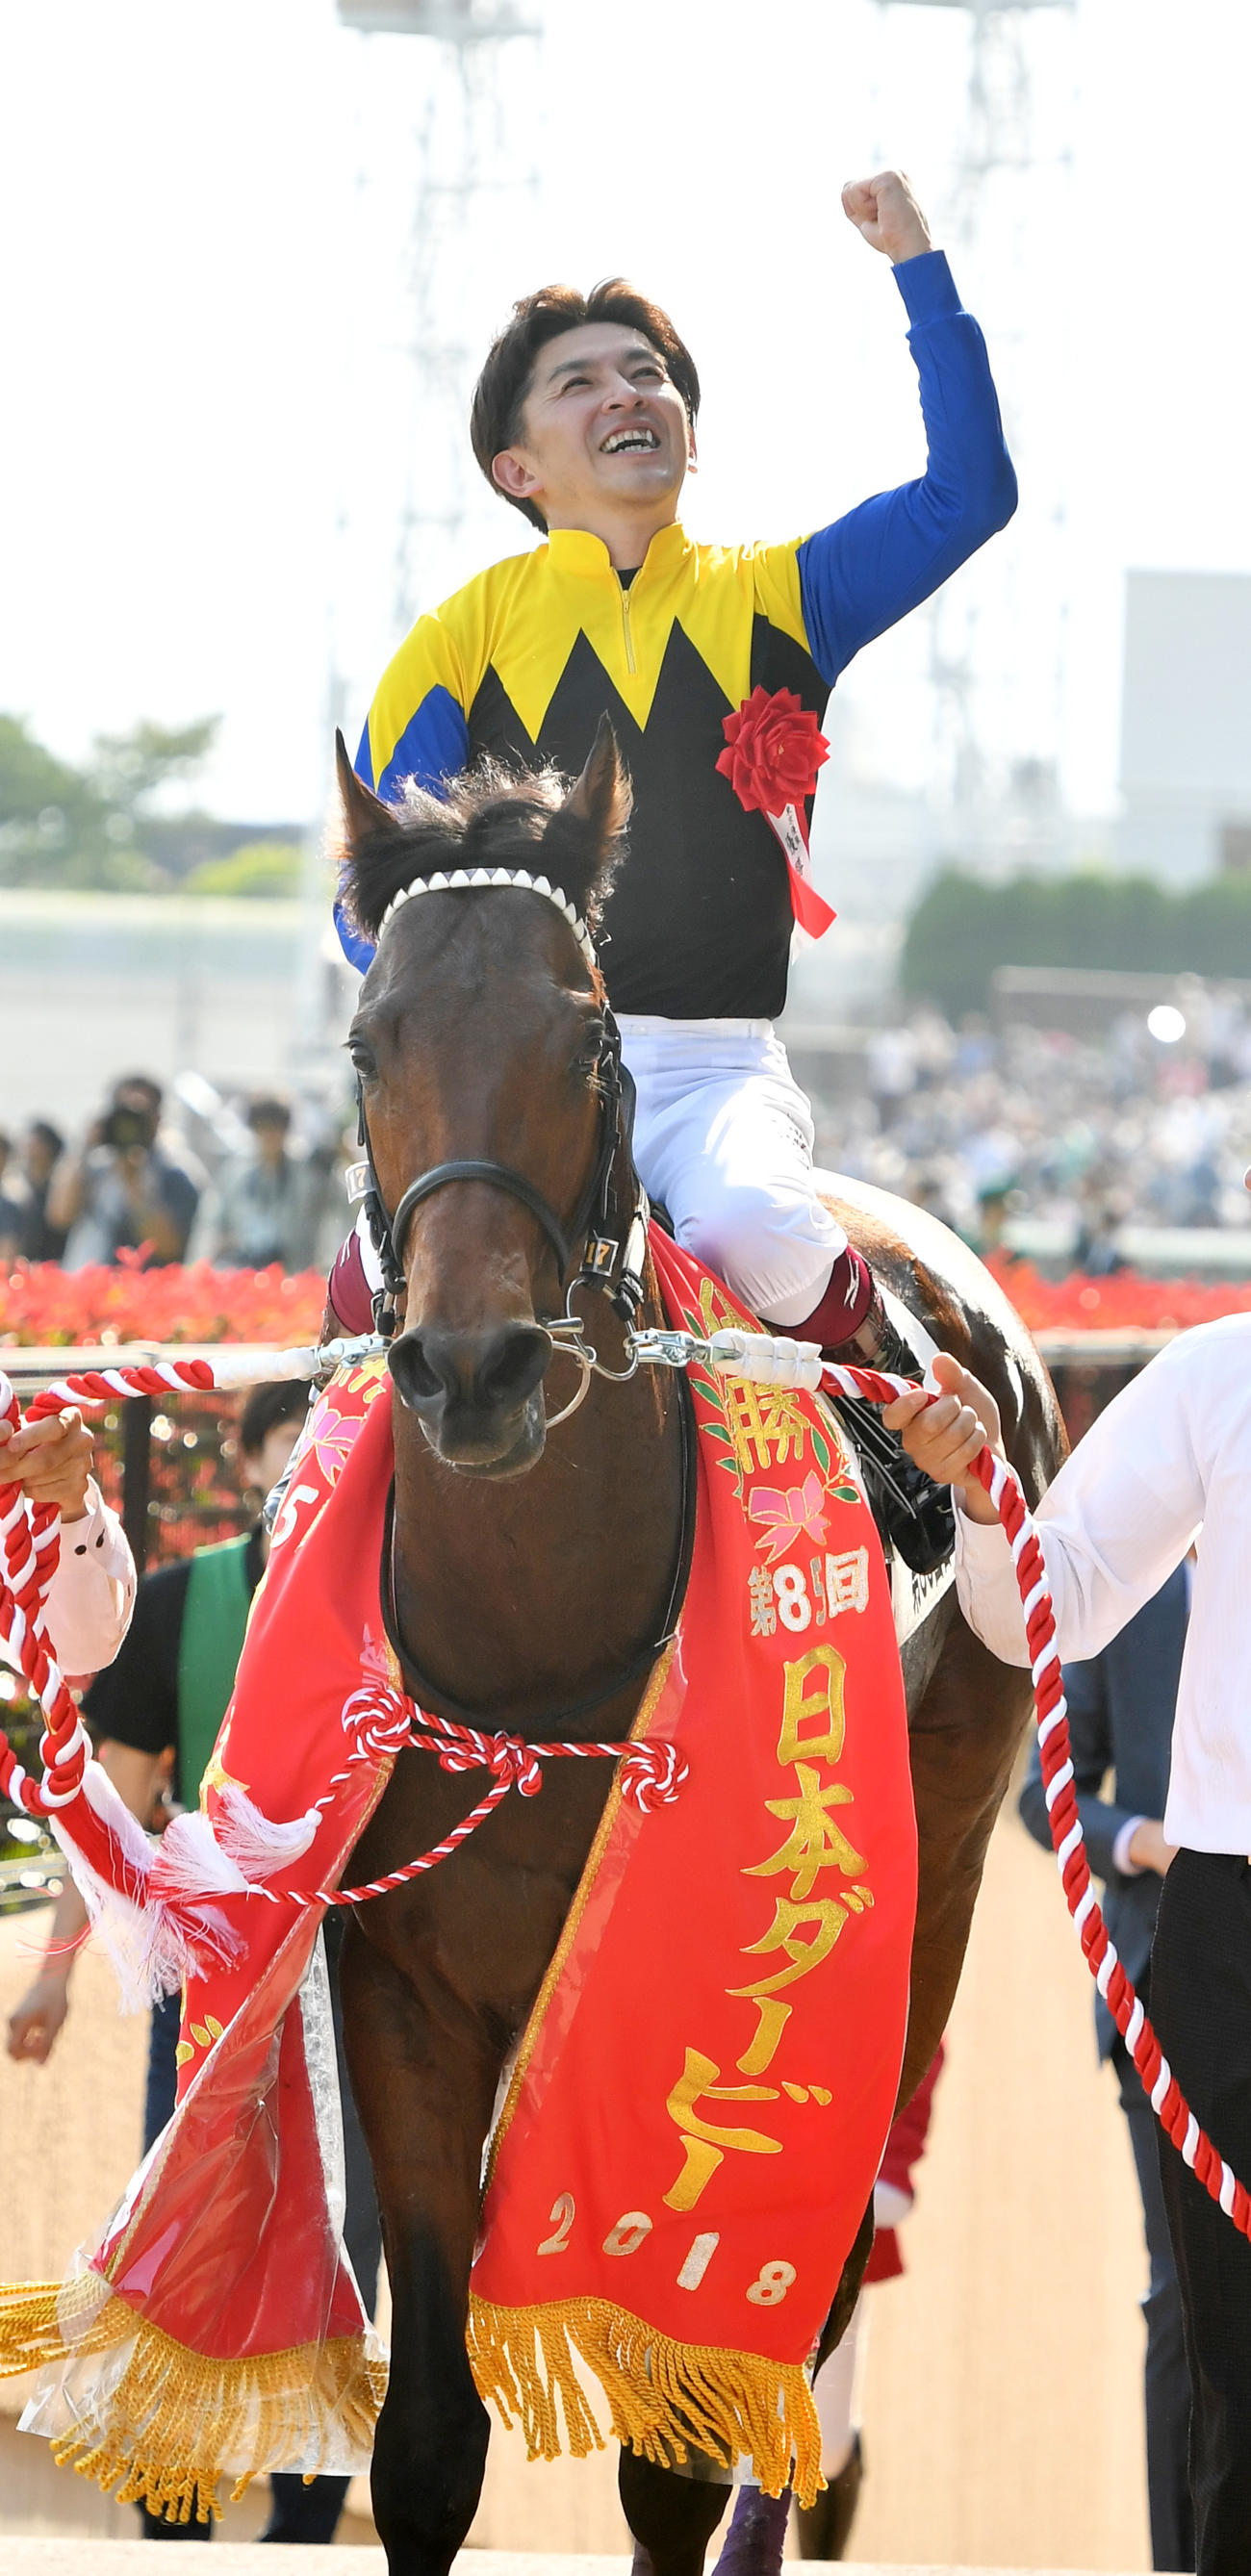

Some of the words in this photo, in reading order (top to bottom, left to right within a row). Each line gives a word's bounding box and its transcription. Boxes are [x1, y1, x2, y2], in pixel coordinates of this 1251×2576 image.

[586, 1242, 610, 1265] 17
[662, 1644, 875, 2211] 日本ダービー
[536, 2192, 797, 2307] 2018
